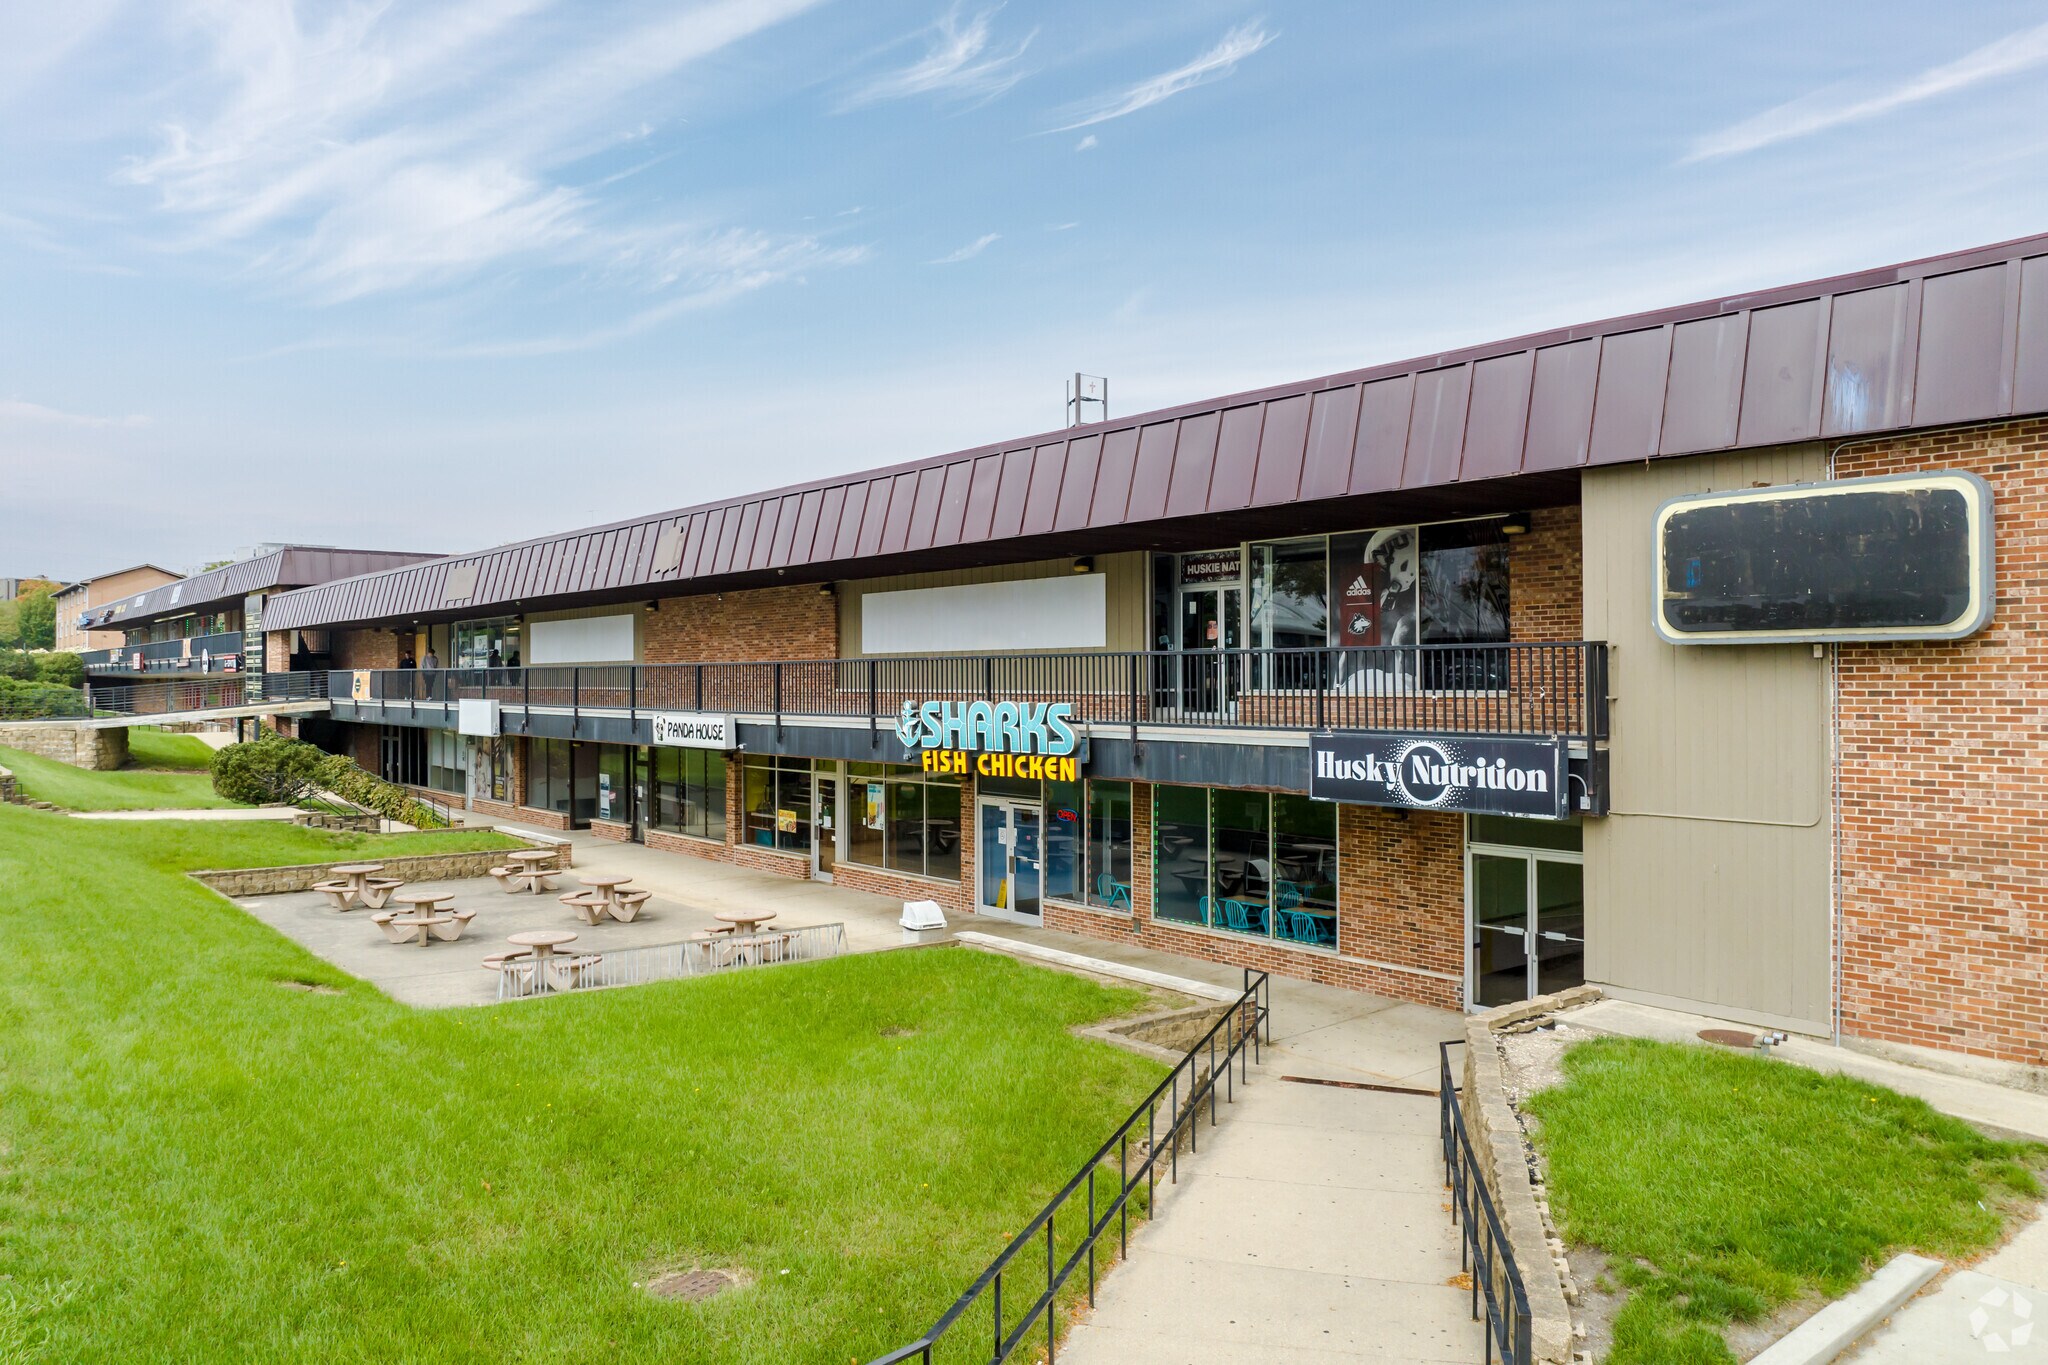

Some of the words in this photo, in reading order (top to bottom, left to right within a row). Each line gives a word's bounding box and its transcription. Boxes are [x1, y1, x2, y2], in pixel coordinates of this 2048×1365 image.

[1187, 562, 1220, 575] HUSKIE
[1346, 588, 1371, 596] adidas
[667, 722, 694, 739] PANDA
[695, 723, 724, 741] HOUSE
[921, 701, 1077, 756] SHARKS
[921, 750, 967, 774] FISH
[977, 753, 1077, 782] CHICKEN
[1317, 750, 1402, 791] Husky
[1411, 755, 1548, 793] Nutrition
[1057, 808, 1077, 822] OPEN
